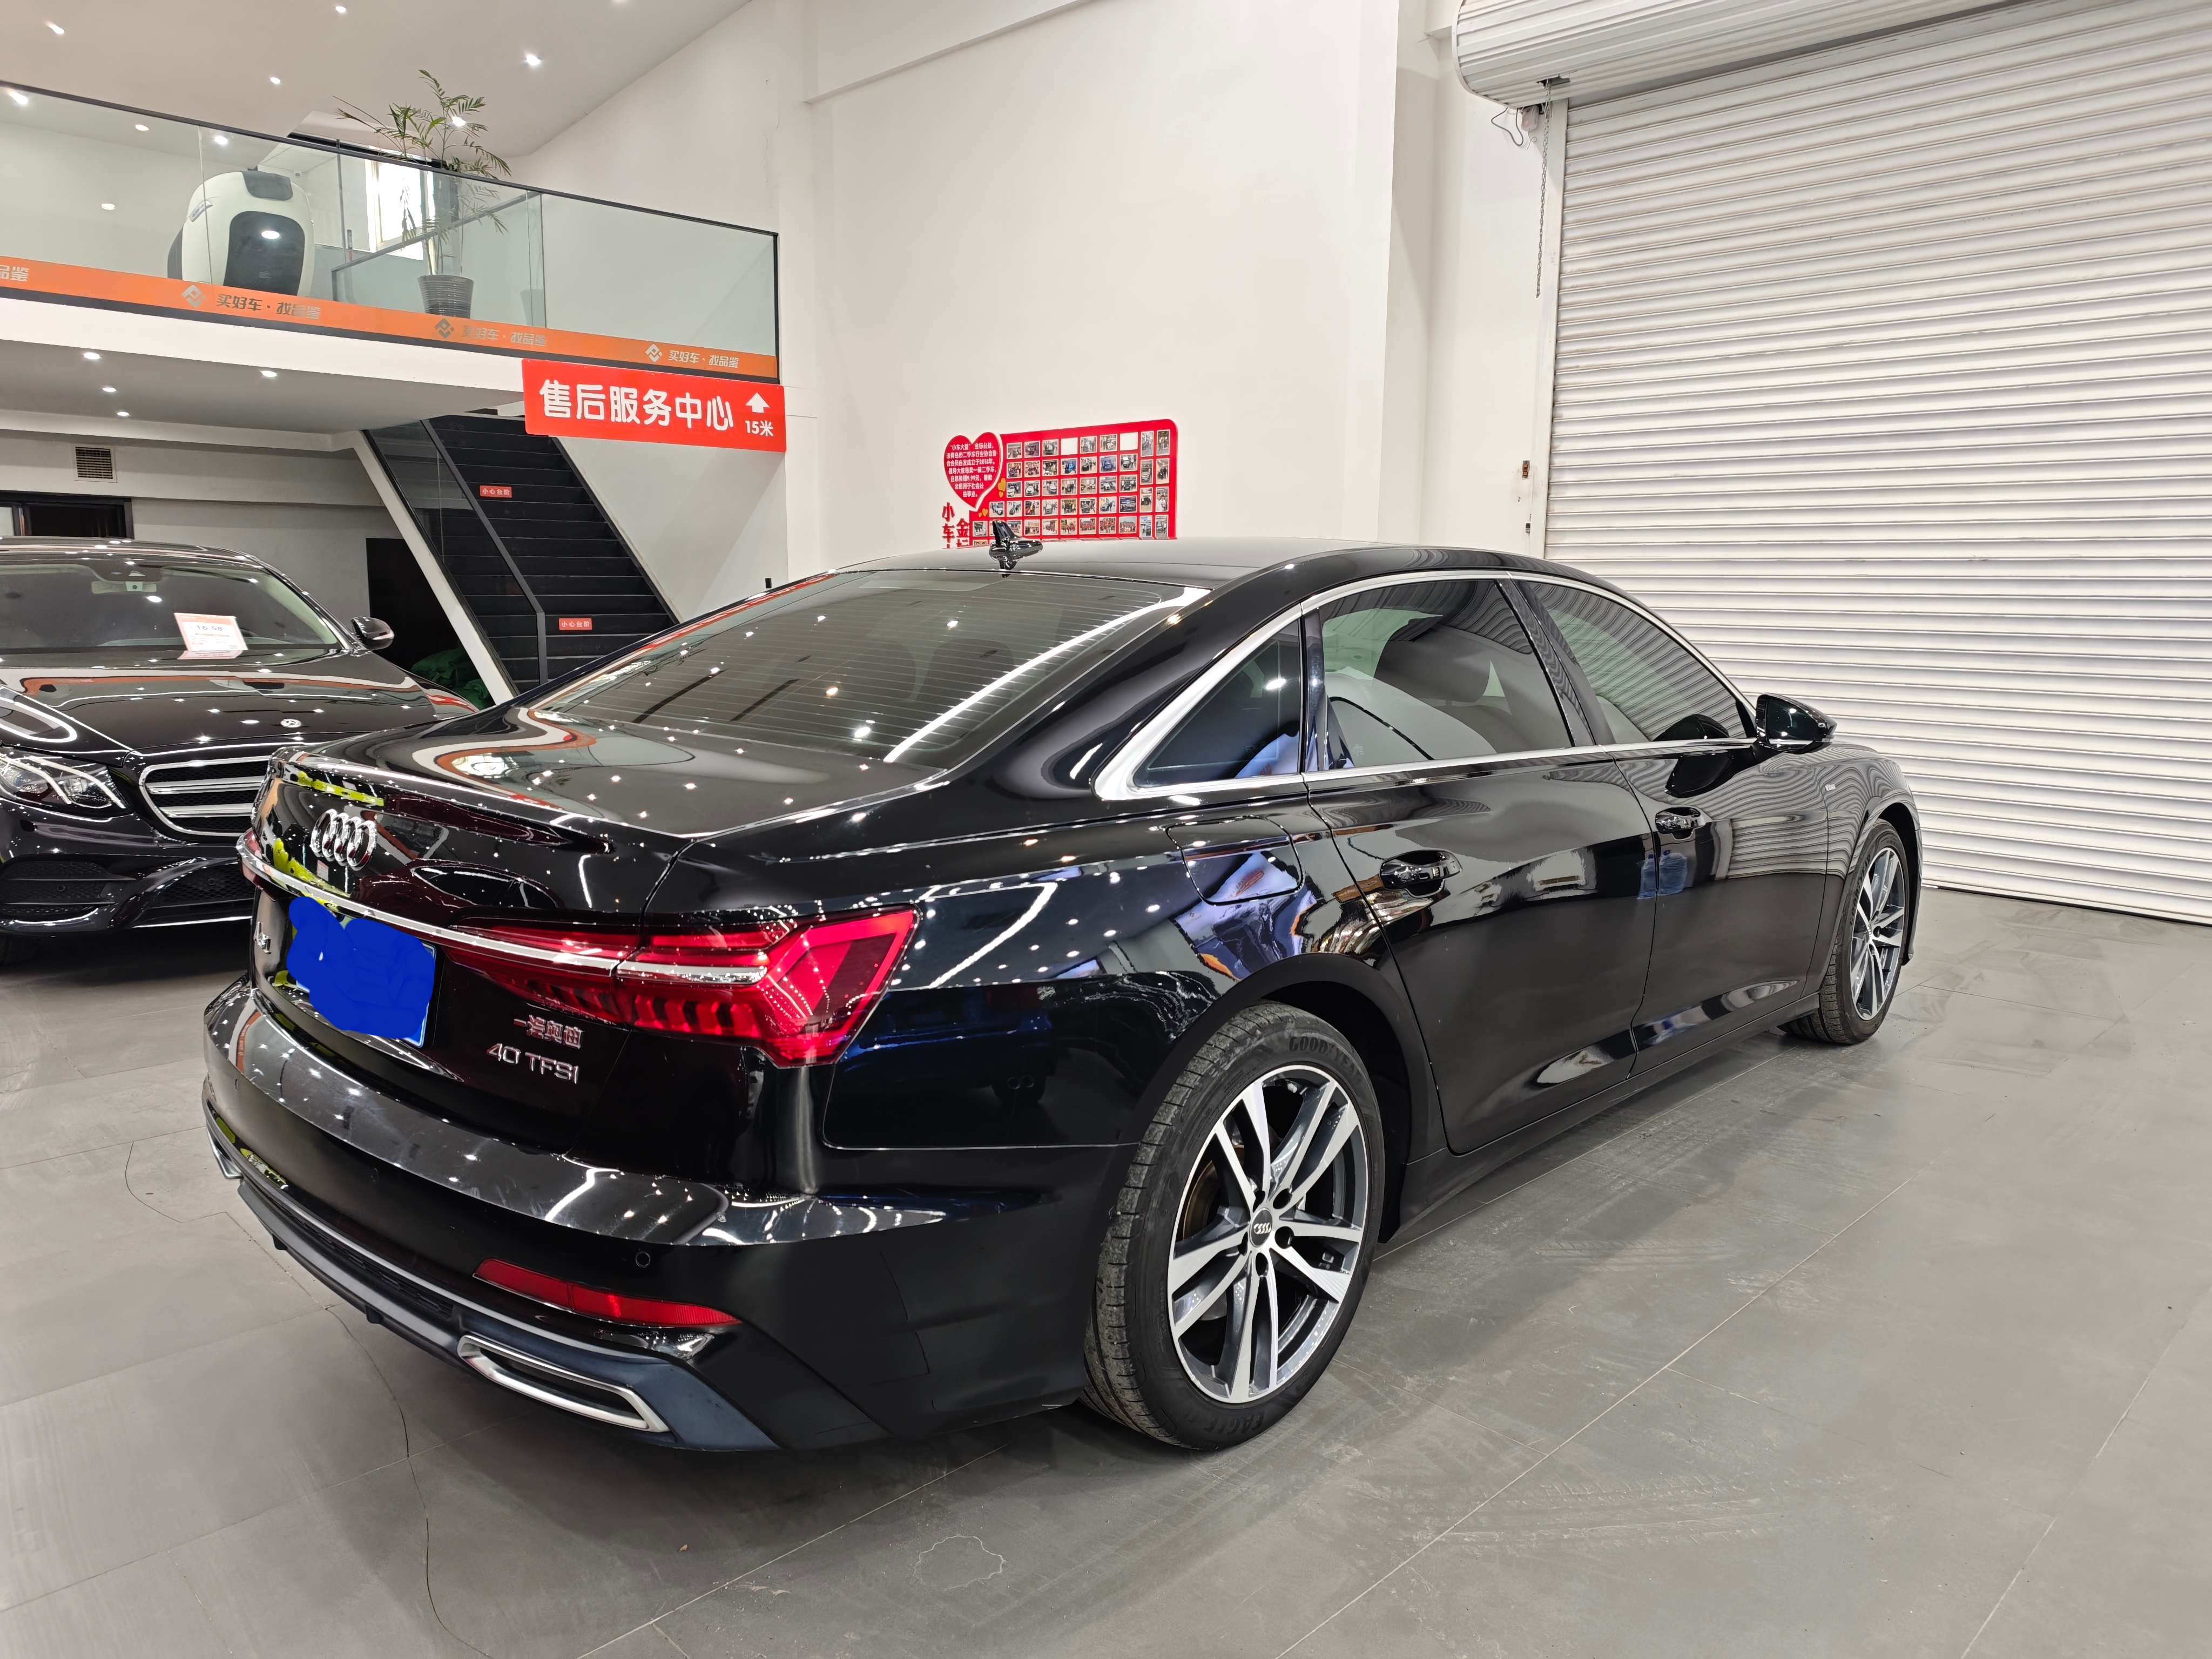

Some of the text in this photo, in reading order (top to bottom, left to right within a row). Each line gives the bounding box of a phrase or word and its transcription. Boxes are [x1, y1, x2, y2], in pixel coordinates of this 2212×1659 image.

[539, 379, 733, 431] 售后服务中心
[745, 420, 774, 437] 15米
[482, 488, 510, 496] 小心台阶
[942, 502, 955, 549] 小车
[487, 1043, 579, 1084] 40 TFSI
